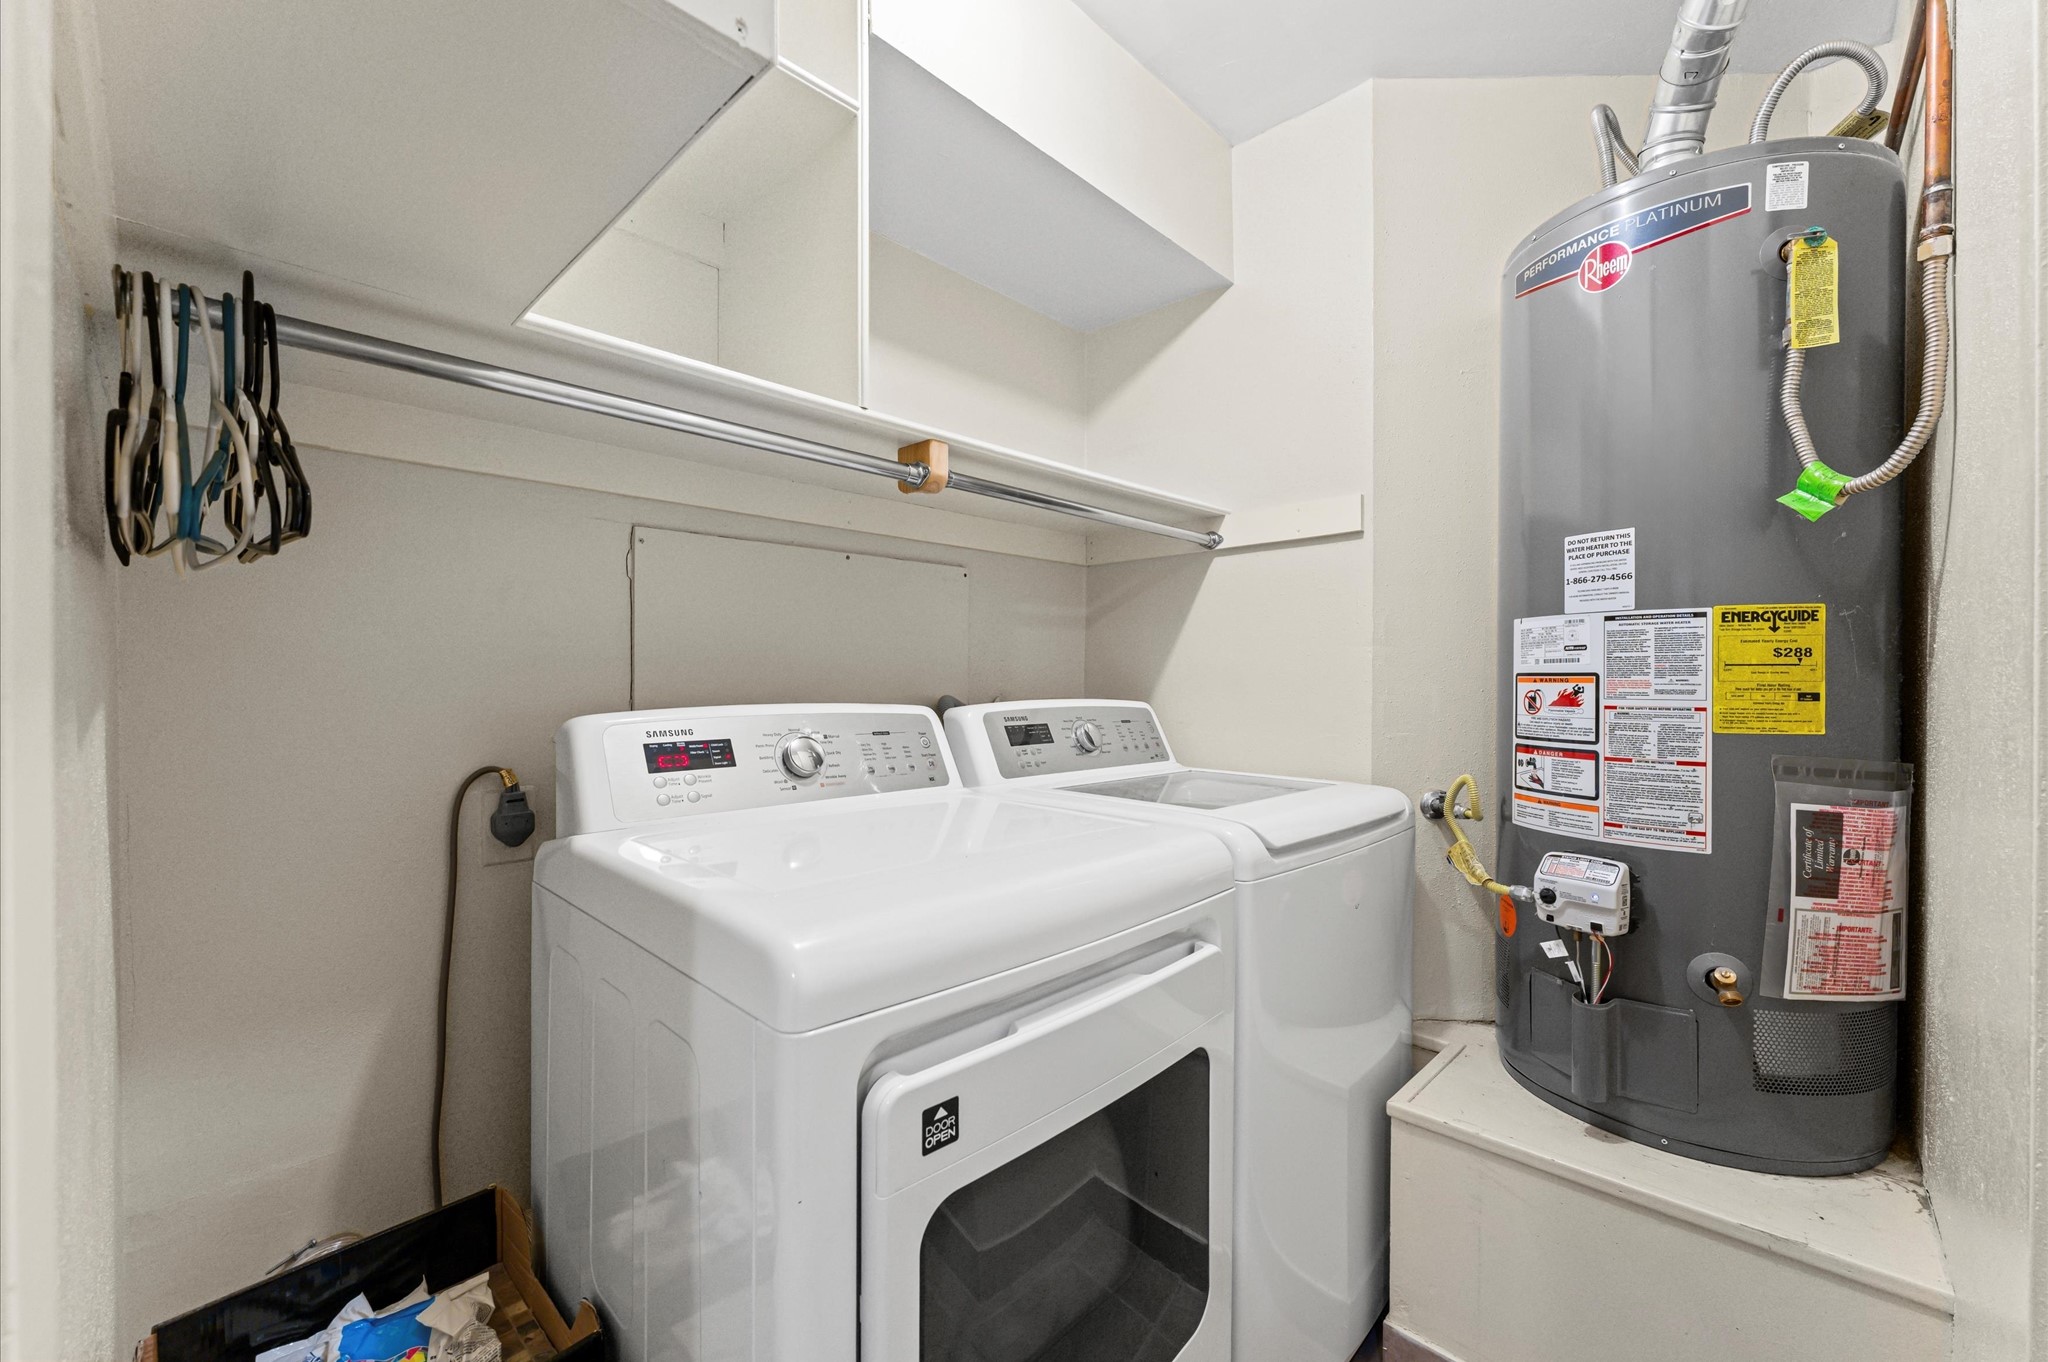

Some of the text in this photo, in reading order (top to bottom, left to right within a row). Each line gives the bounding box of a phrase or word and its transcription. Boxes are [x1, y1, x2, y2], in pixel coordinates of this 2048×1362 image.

[1523, 224, 1620, 282] PERFORMANCE
[1624, 193, 1722, 232] PLATINUM
[1584, 247, 1629, 289] Rheem
[1577, 537, 1590, 545] NOT
[1590, 534, 1615, 543] RETURN
[1616, 532, 1631, 540] THIS
[1566, 546, 1586, 554] WATER
[1585, 543, 1609, 551] HEATER
[1568, 553, 1586, 561] PLACE
[1596, 548, 1630, 557] PURCHASE
[1565, 572, 1633, 586] 1-866-279-4566
[1721, 609, 1819, 625] ENERGYGUIDE
[1773, 647, 1813, 658] $288
[1003, 715, 1029, 723] SAMSUNG
[645, 728, 694, 739] SAMSUNG
[1802, 825, 1814, 879] Certificate of
[1814, 838, 1825, 870] Limited
[1825, 836, 1837, 873] Warranty
[1836, 925, 1873, 934] IMPORTANTE
[925, 1115, 956, 1138] DOOR
[925, 1126, 956, 1149] OPEN
